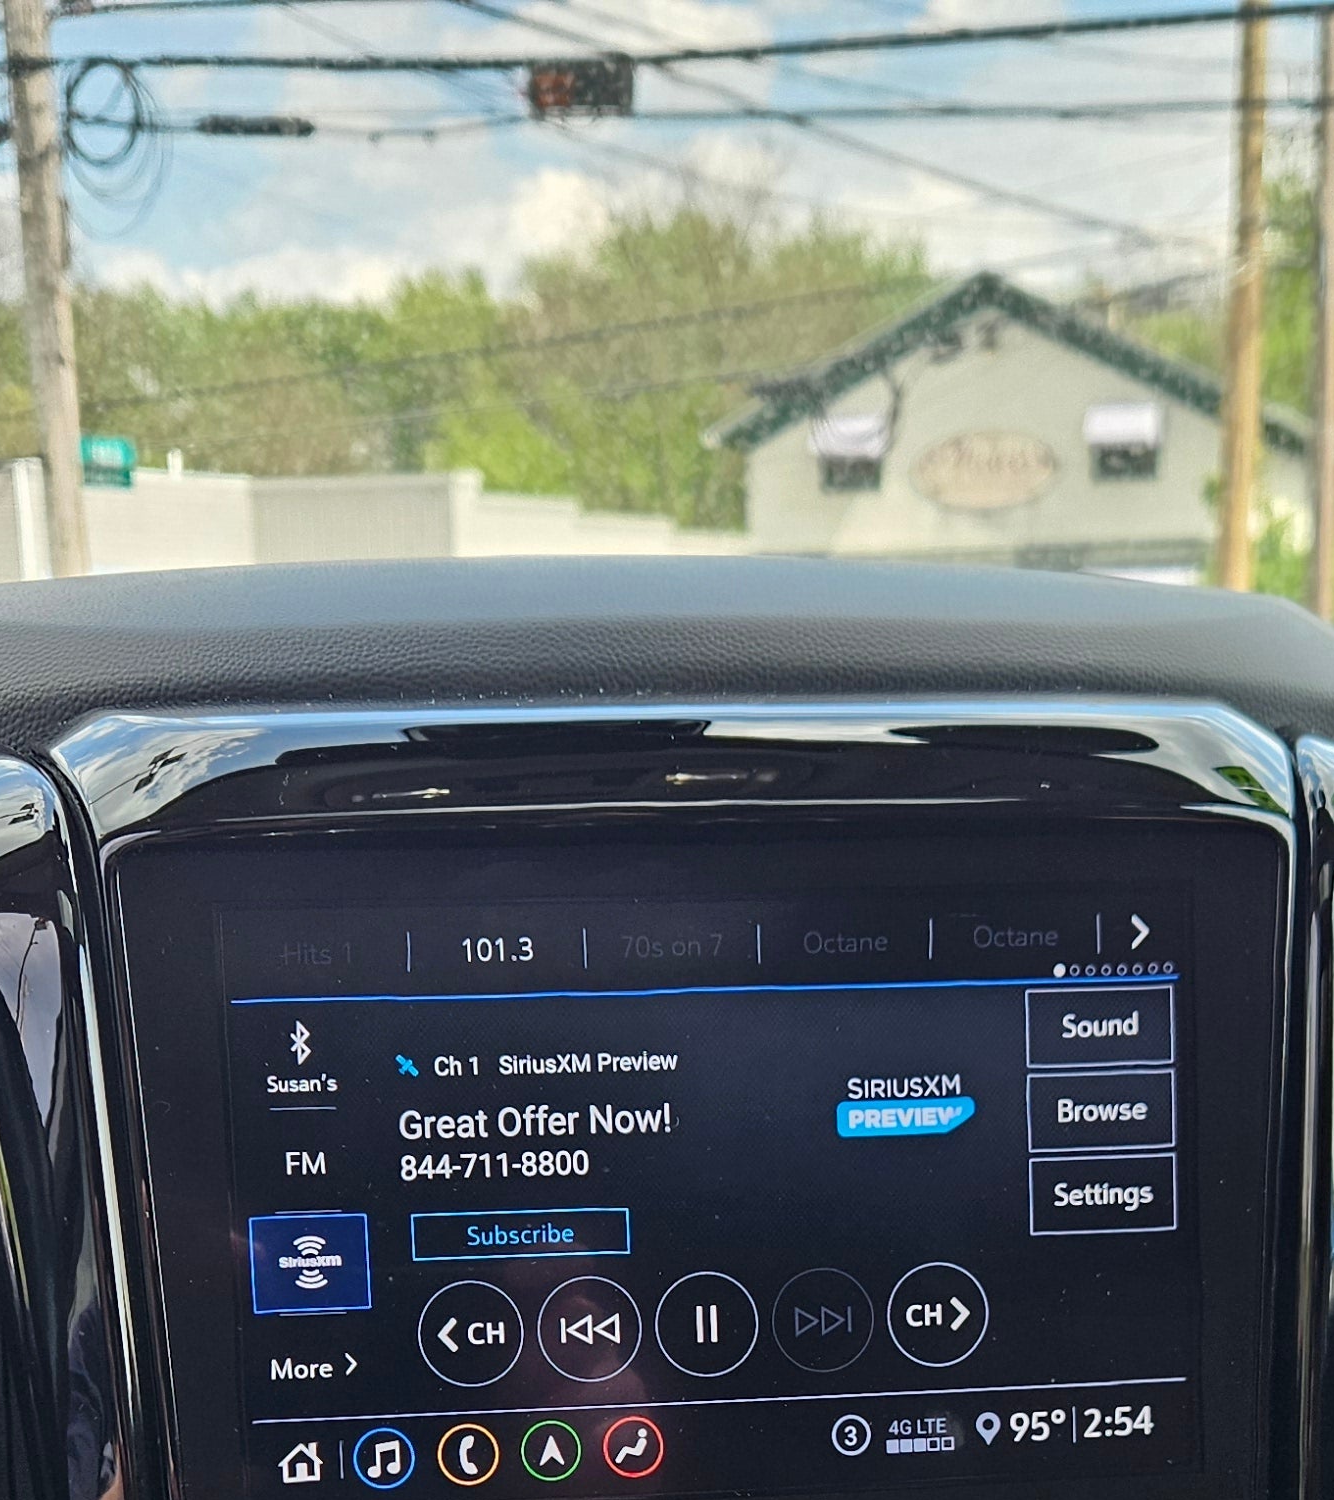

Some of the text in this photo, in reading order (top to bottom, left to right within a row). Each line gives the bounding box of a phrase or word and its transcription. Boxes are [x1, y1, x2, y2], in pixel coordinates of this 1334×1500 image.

[622, 934, 723, 959] 70s on 7
[803, 931, 889, 955] Octane
[973, 924, 1059, 949] Octane
[279, 944, 333, 966] Hits
[461, 937, 535, 963] 101.3
[1061, 1010, 1140, 1040] Sound
[433, 1051, 679, 1077] Ch 1 SiriusXM Preview
[266, 1074, 338, 1094] Susan's
[398, 1102, 673, 1140] Great Offer Now!
[848, 1105, 964, 1130] PREVIEW
[1056, 1097, 1149, 1124] Browse
[284, 1151, 328, 1176] FM
[399, 1149, 590, 1182] 844-711-8800
[1053, 1182, 1155, 1212] Settings
[466, 1223, 575, 1247] Subscribe
[905, 1302, 943, 1328] CH
[467, 1321, 506, 1346] CH
[269, 1358, 334, 1381] More
[843, 1425, 858, 1445] 3
[888, 1417, 947, 1436] 4G LTE
[1083, 1405, 1155, 1440] 2:54
